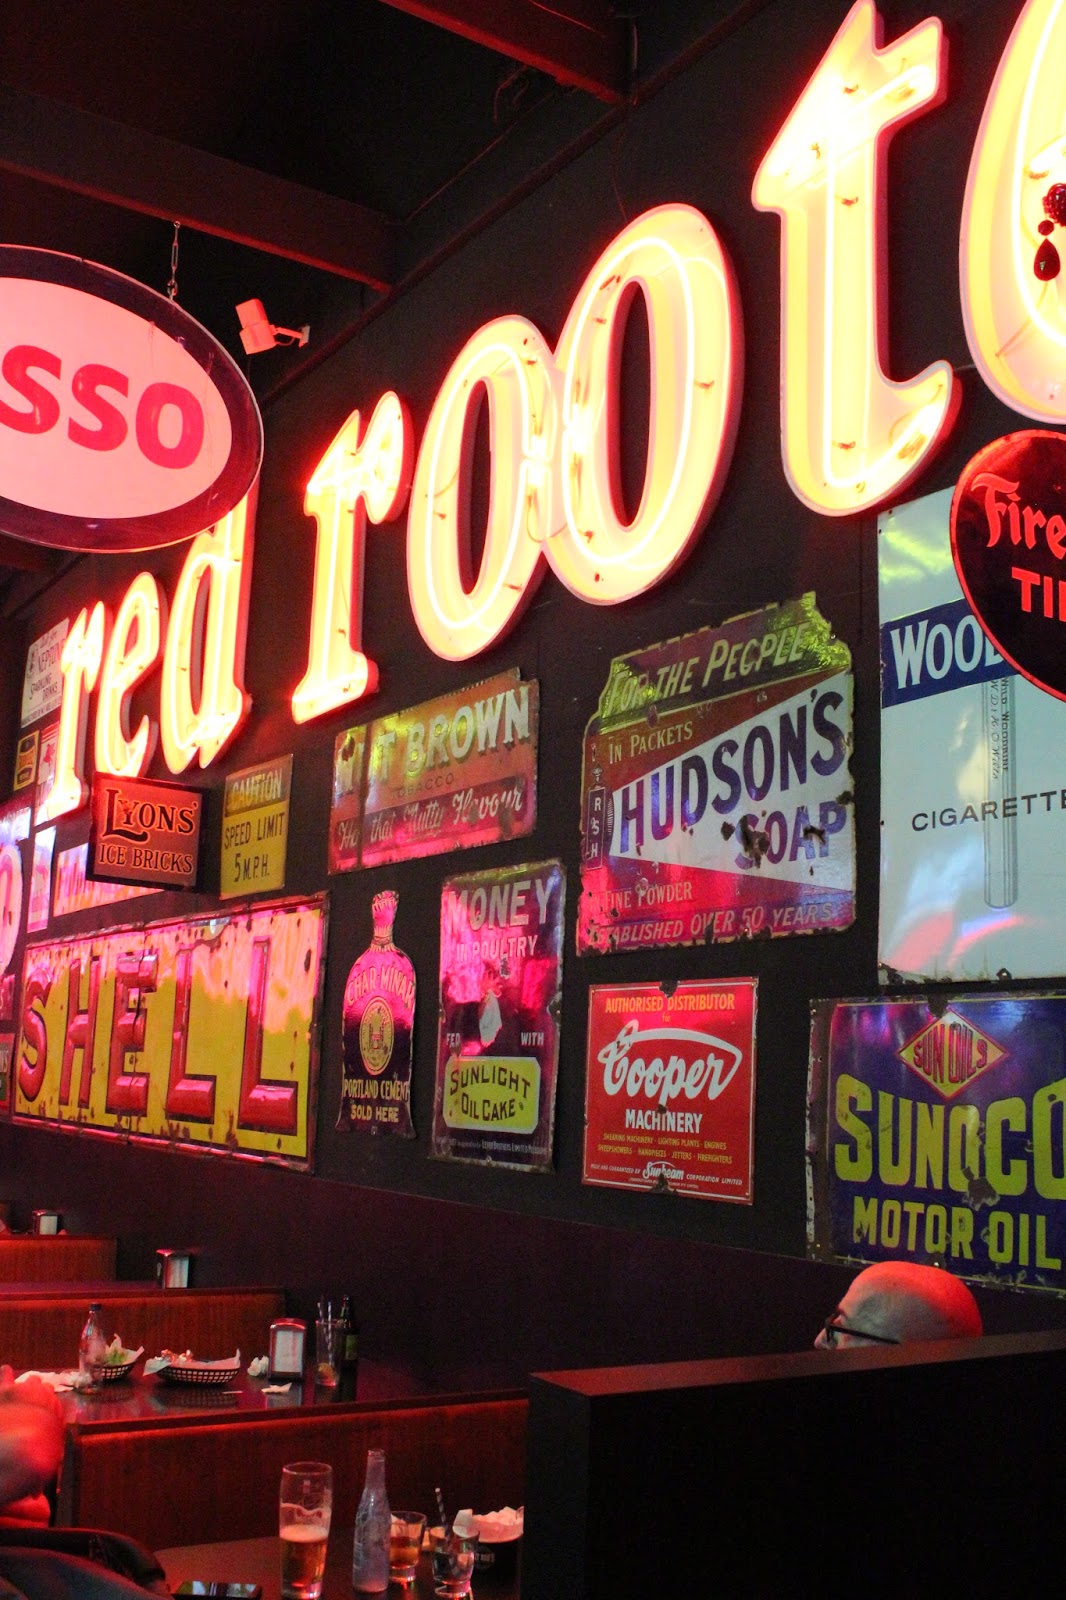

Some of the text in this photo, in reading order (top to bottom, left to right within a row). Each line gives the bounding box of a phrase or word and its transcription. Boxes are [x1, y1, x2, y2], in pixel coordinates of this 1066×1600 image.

[607, 670, 656, 715] FOR
[656, 657, 700, 698] THE
[406, 685, 530, 779] BROWN
[609, 721, 693, 764] IN PACKETS
[231, 767, 283, 806] CAUTION
[619, 688, 846, 854] HUDSON'S
[224, 811, 285, 849] SPEED LIMIT
[734, 800, 848, 870] SOAP
[100, 844, 194, 873] ICE BRICKS
[234, 852, 241, 882] 5
[447, 876, 555, 934] MONEY
[638, 881, 693, 907] POWDER
[690, 910, 734, 936] OVER
[743, 905, 764, 932] 50
[773, 901, 832, 928] YEARS
[472, 934, 538, 960] POULTRY
[605, 993, 735, 1014] AUTHORISED DISTRIBUTOR
[17, 932, 299, 1137] SHELL
[446, 1032, 545, 1048] FED WITH
[913, 1020, 988, 1084] SUN OILS
[597, 1018, 743, 1107] Cooper
[344, 1078, 410, 1100] PORTLAND CEMENT
[450, 1064, 531, 1099] SUNLIGHT
[351, 1104, 399, 1123] SOLD HERE
[461, 1092, 516, 1122] OIL CAKE
[625, 1108, 703, 1134] MACHINERY
[603, 1132, 727, 1150] SHEARING MACHINERY LIGHTING PLANTS ENGINES
[834, 1072, 1066, 1201] SUNOCO
[642, 1160, 685, 1181] Sunbeam
[686, 1172, 720, 1183] CORPORATION
[721, 1177, 743, 1187] LIMITED
[671, 1150, 692, 1160] JETTERS
[697, 1152, 733, 1165] FIREFIGHTERS
[852, 1195, 1062, 1271] MOTOR OIL
